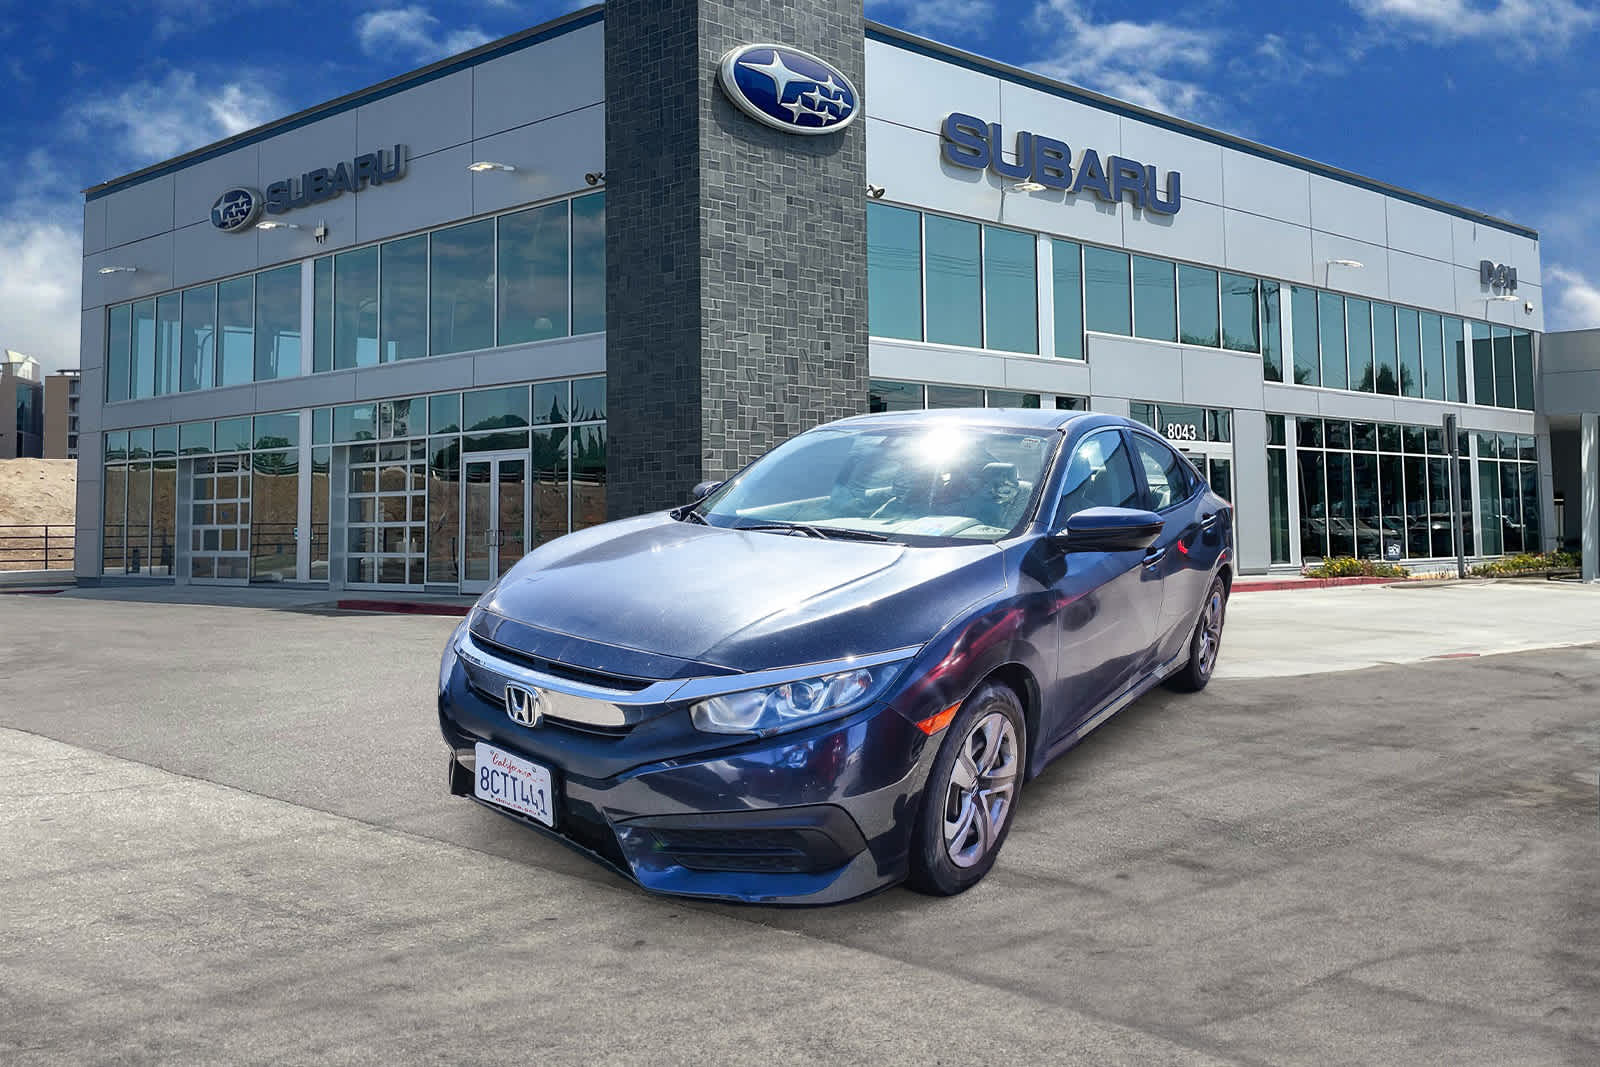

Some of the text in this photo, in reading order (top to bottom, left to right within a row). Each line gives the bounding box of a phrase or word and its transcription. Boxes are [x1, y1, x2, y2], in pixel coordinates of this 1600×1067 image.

[265, 143, 405, 215] SUBARU
[944, 111, 1182, 216] SUBARU
[1167, 422, 1197, 440] 8043
[491, 752, 532, 778] California
[480, 766, 548, 816] 8CTT441
